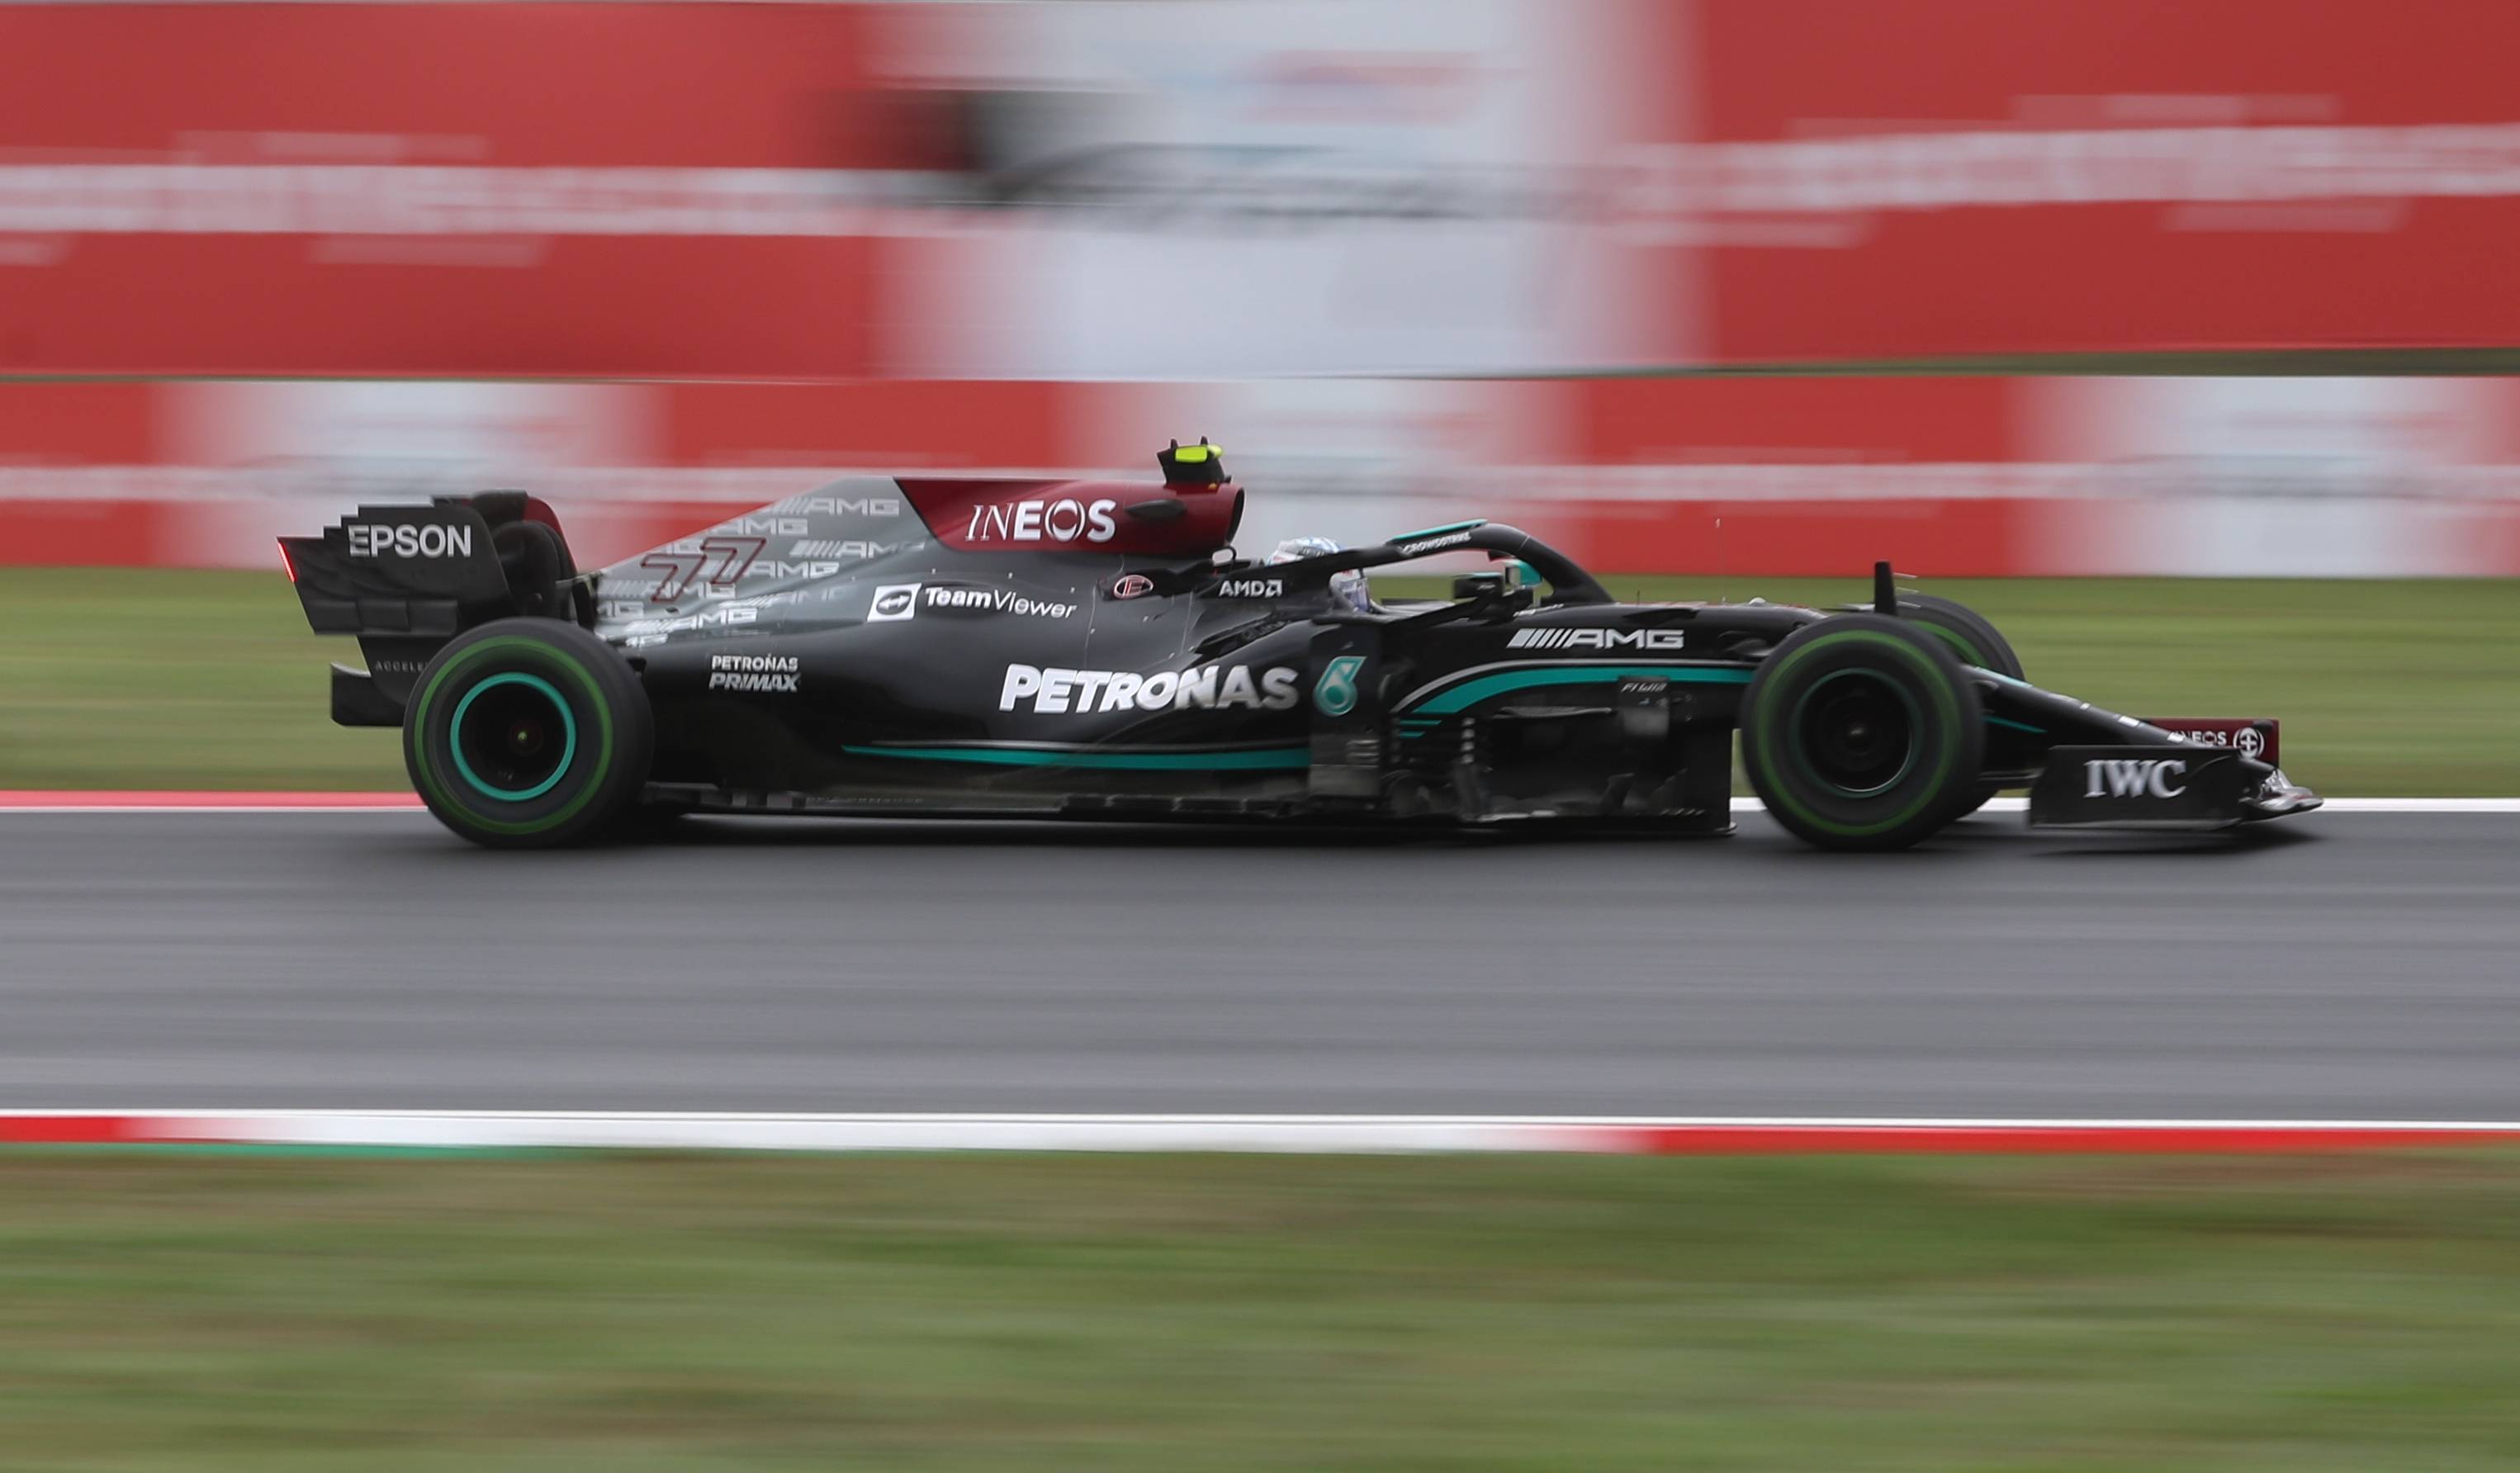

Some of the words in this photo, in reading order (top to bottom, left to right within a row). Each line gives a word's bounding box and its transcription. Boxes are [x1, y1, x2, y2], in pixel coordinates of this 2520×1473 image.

[804, 497, 900, 517] AMG
[964, 499, 1116, 542] INEOS
[348, 523, 471, 559] EPSON
[641, 537, 766, 603] 77
[742, 560, 841, 579] AMG
[925, 586, 1078, 619] TeamViewer
[1561, 628, 1684, 650] AMG
[375, 660, 429, 673] ACCELE
[711, 655, 798, 672] PETRONAS
[708, 671, 801, 693] PRIMAX
[998, 663, 1300, 713] PETRONAS
[2173, 730, 2228, 746] EOS
[2083, 760, 2187, 798] IWC
